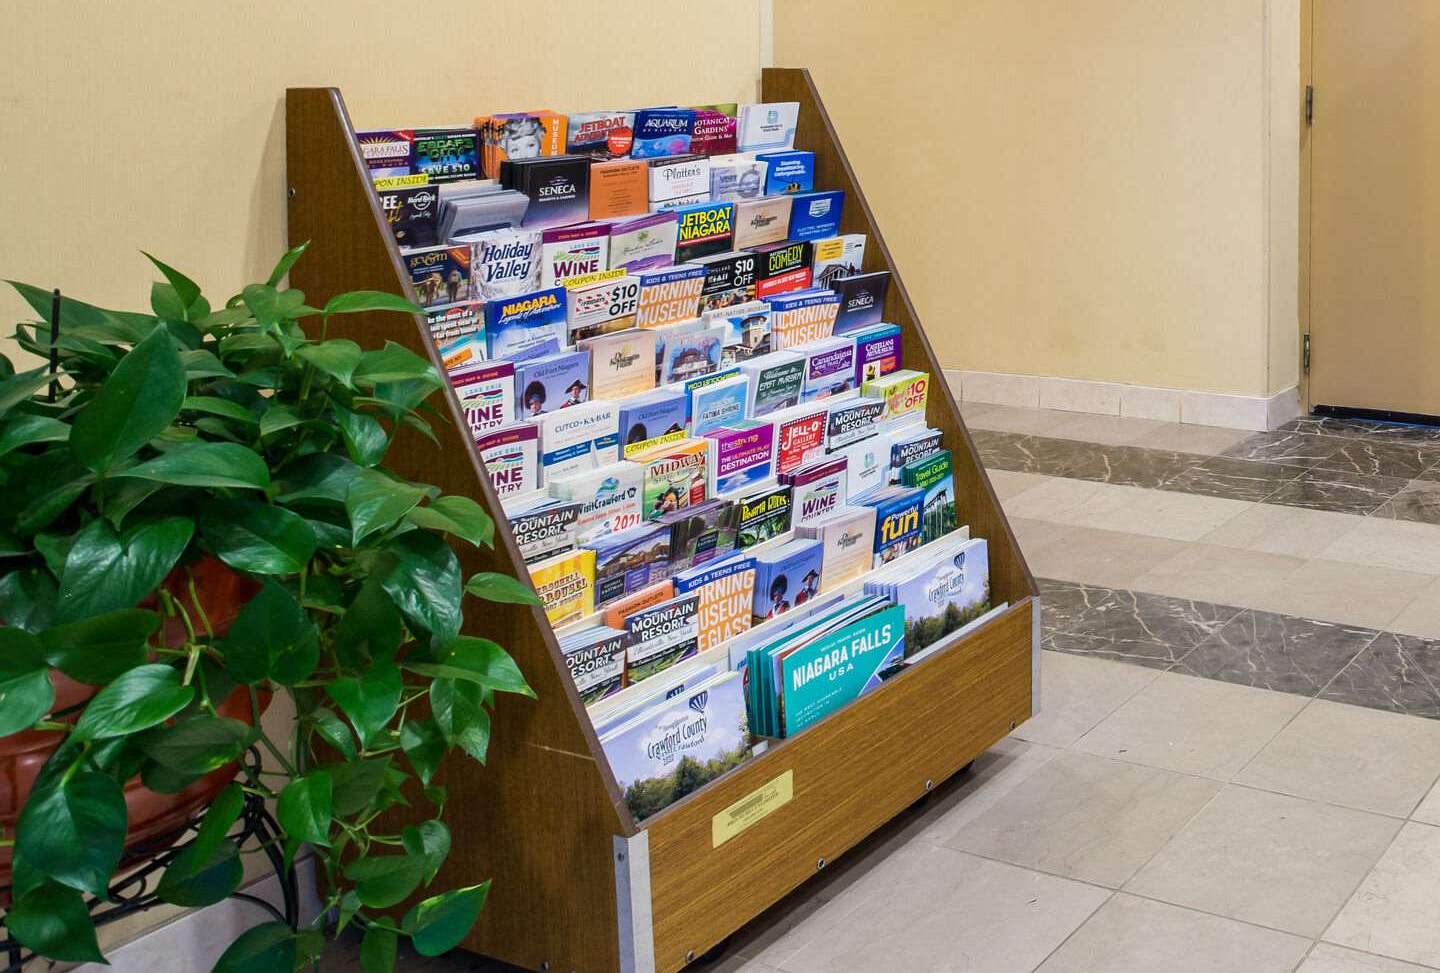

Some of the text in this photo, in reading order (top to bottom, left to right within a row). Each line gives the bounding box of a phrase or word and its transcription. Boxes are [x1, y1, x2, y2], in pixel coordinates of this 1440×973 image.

[579, 116, 625, 133] JETBOAT
[645, 119, 688, 128] AQUARIUM
[695, 125, 728, 135] GARDENS
[422, 164, 470, 174] SAVE $10
[663, 165, 700, 180] Platter's
[397, 175, 426, 186] INSIDE
[539, 184, 576, 196] SENECA
[680, 207, 732, 227] JETBOAT
[679, 221, 730, 240] NIAGARA
[482, 241, 533, 264] Holiday
[769, 244, 804, 272] COMEDY
[486, 261, 531, 282] Valley
[553, 260, 599, 278] WINE
[646, 276, 660, 284] KIDS
[688, 269, 703, 277] FREE
[735, 259, 754, 274] $10
[563, 269, 625, 286] COUPON INSIDE
[734, 274, 753, 286] OFF
[611, 284, 638, 302] $10
[640, 278, 705, 305] CORNING
[847, 296, 874, 307] SENECA
[502, 294, 557, 316] NIAGARA
[608, 301, 635, 316] OFF
[637, 298, 700, 326] MUSEUM
[784, 304, 840, 326] CORNING
[783, 319, 834, 346] MUSEUM
[904, 392, 925, 408] OFF
[703, 409, 720, 420] FATIMA
[835, 406, 881, 426] MOUNTAIN
[555, 420, 579, 433] CUTCO
[841, 417, 872, 433] RESORT
[626, 432, 686, 453] COUPON INSIDE
[901, 438, 939, 458] MOUNTAIN
[650, 451, 705, 476] MIDWAY
[721, 451, 769, 472] DESTINATION
[802, 493, 837, 516] WINE
[891, 504, 919, 520] Powerful
[516, 522, 562, 545] RESORT
[881, 511, 918, 543] fun
[689, 580, 702, 588] KIDS
[711, 567, 732, 579] TEENS
[734, 562, 750, 570] FREE
[929, 574, 964, 602] Crawford County
[631, 602, 694, 633] MOUNTAIN
[641, 616, 685, 641] RESORT
[566, 640, 622, 668] OUNTAIN
[793, 624, 892, 692] NIAGARA FALLS
[571, 654, 610, 678] ESORT
[829, 663, 854, 681] USA
[648, 723, 681, 760] Crawford
[682, 715, 708, 742] County
